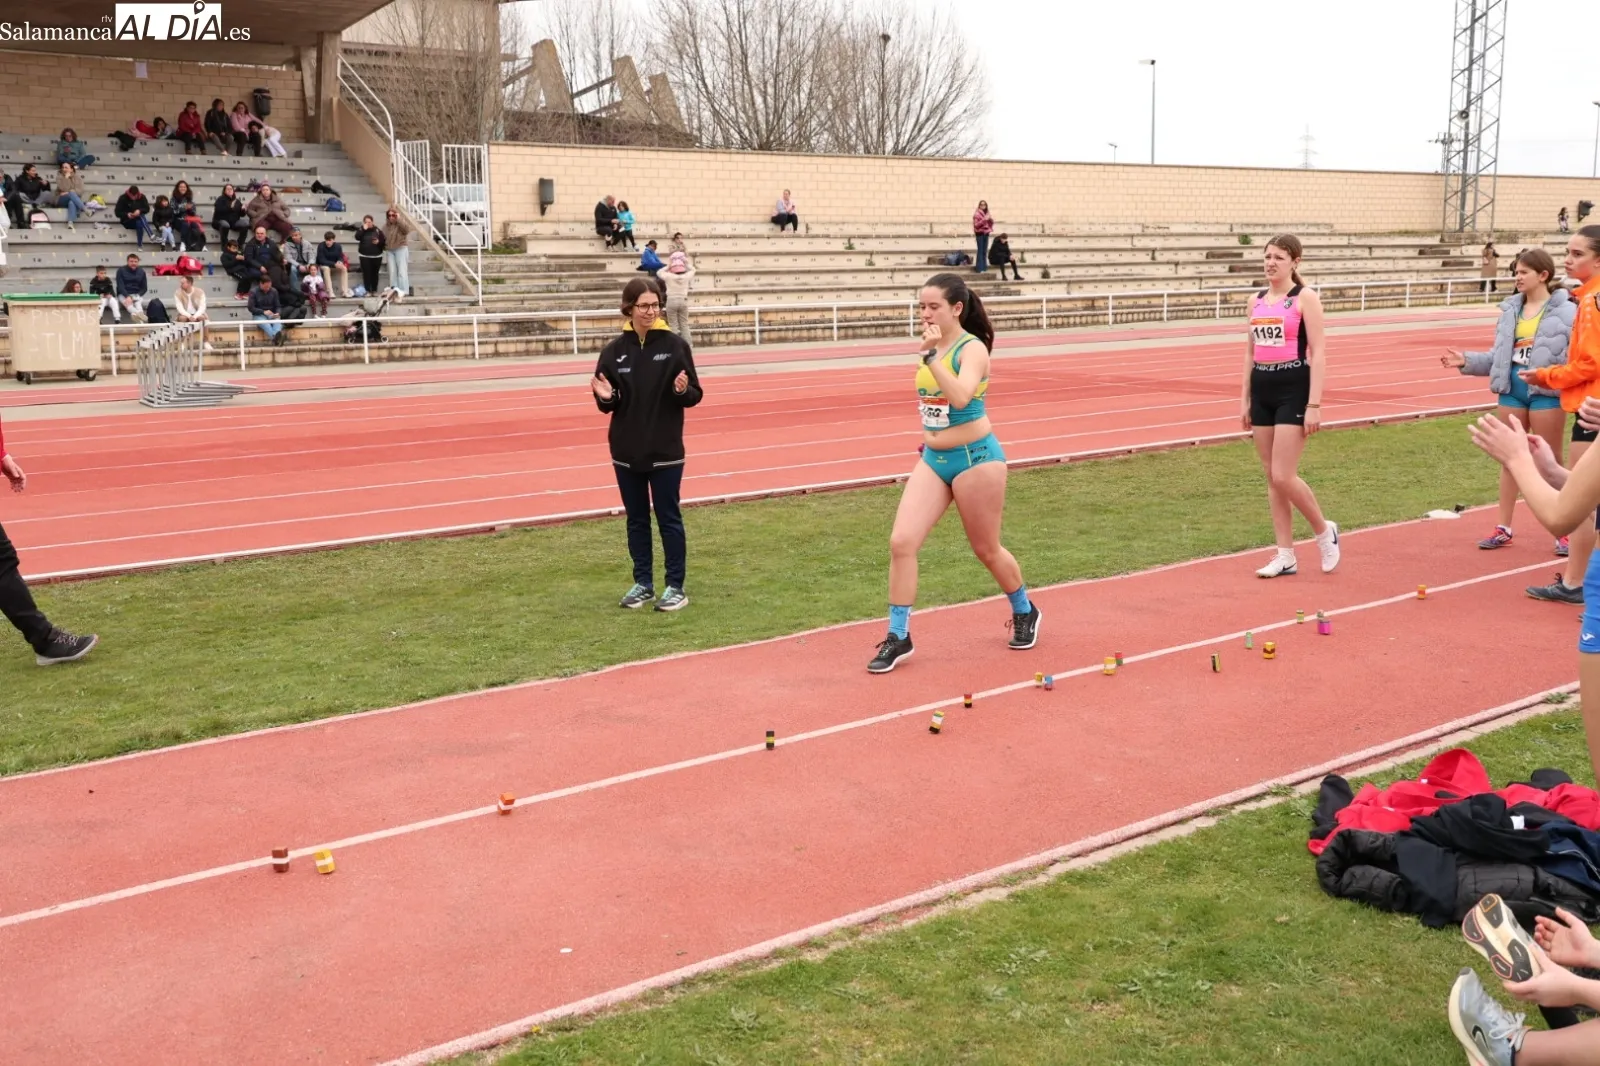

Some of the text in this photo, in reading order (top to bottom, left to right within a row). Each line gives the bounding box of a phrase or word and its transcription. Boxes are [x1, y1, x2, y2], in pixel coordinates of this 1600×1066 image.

[31, 309, 97, 326] PISTAS
[1253, 326, 1283, 339] 1192
[1277, 360, 1302, 371] PRO
